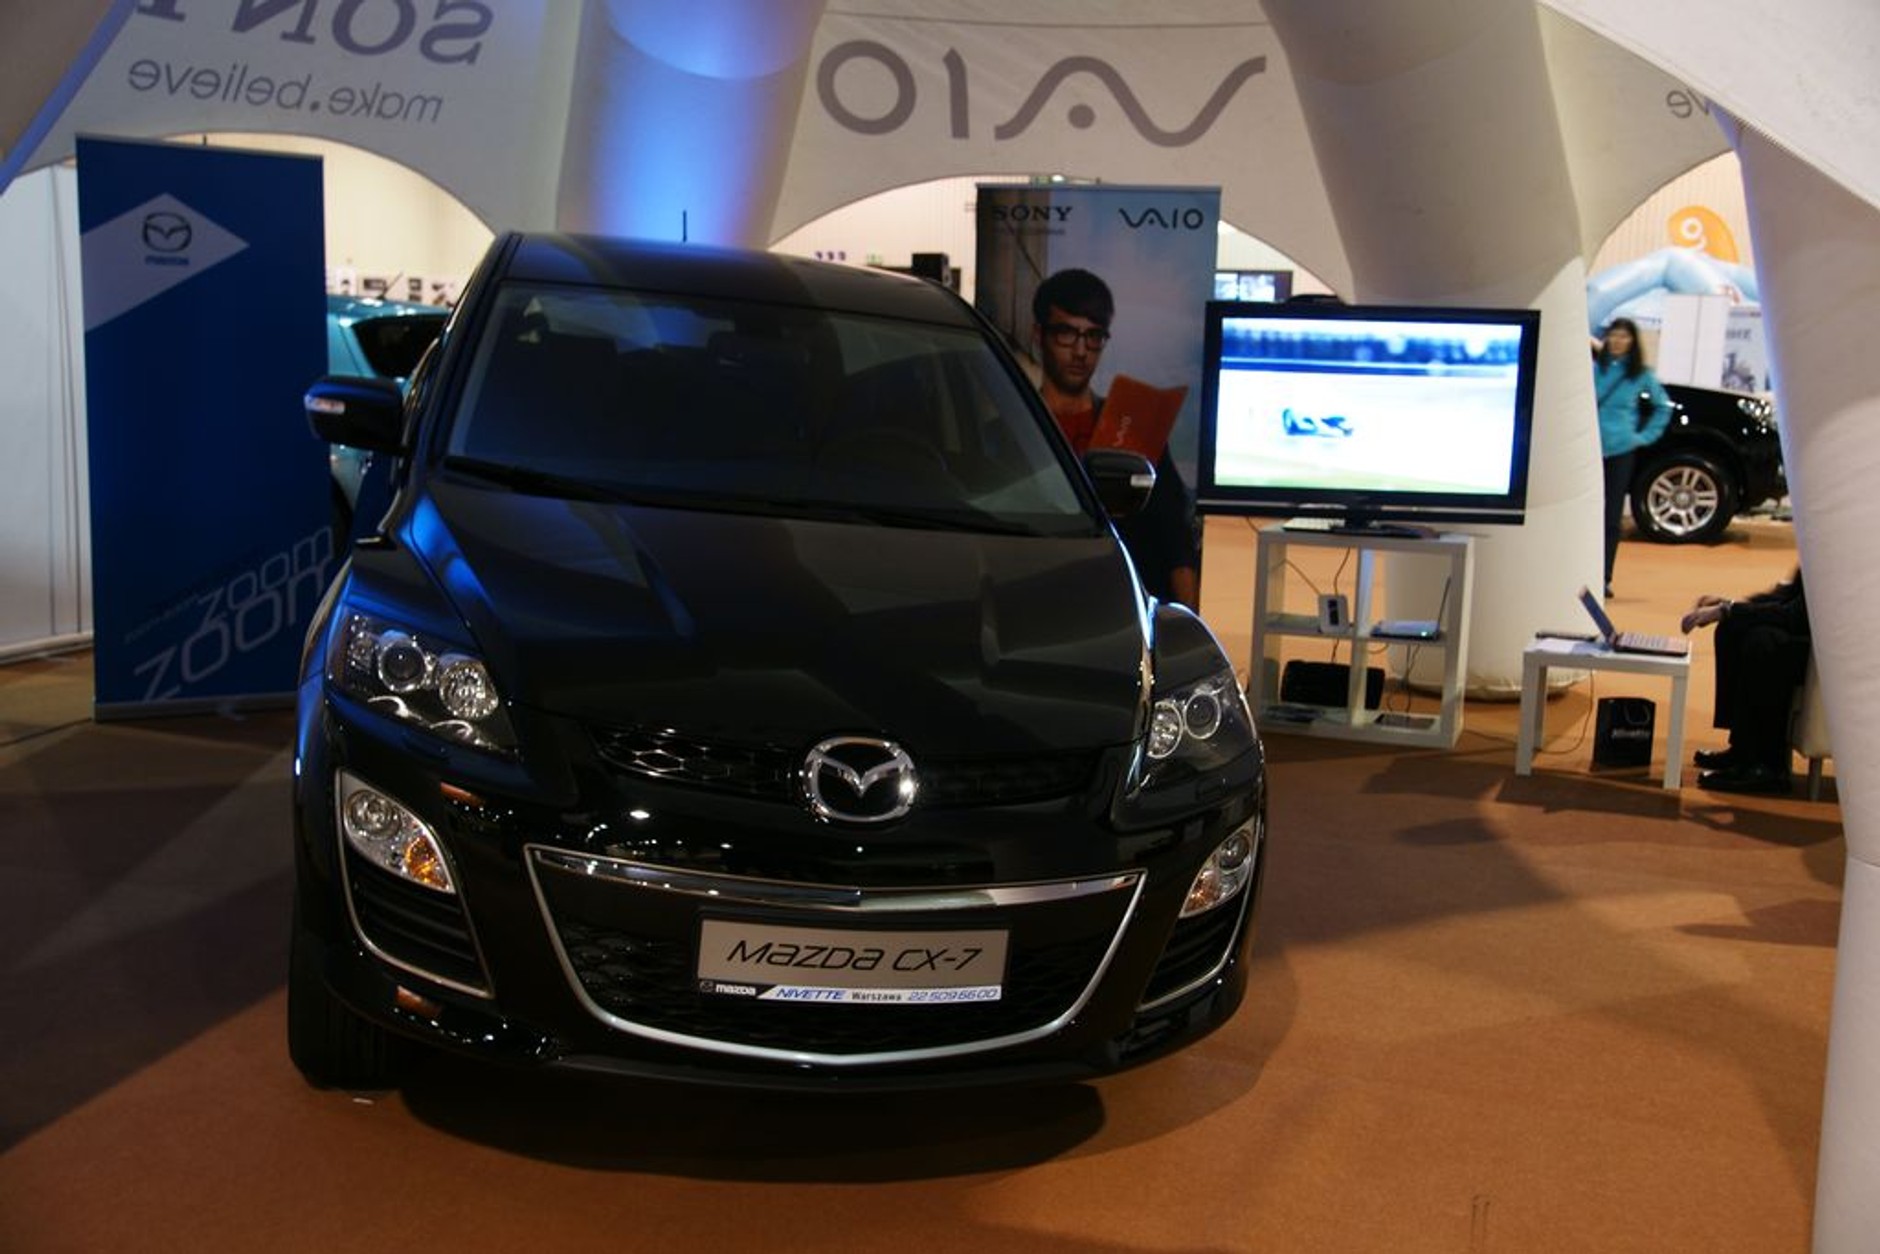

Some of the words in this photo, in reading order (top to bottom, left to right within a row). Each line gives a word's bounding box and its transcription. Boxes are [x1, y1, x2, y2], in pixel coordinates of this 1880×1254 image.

[991, 204, 1073, 222] SONY
[1118, 207, 1205, 230] VAIO
[891, 947, 984, 972] CX-7
[776, 988, 846, 1000] NIVETTE
[852, 991, 902, 1002] Warszawa
